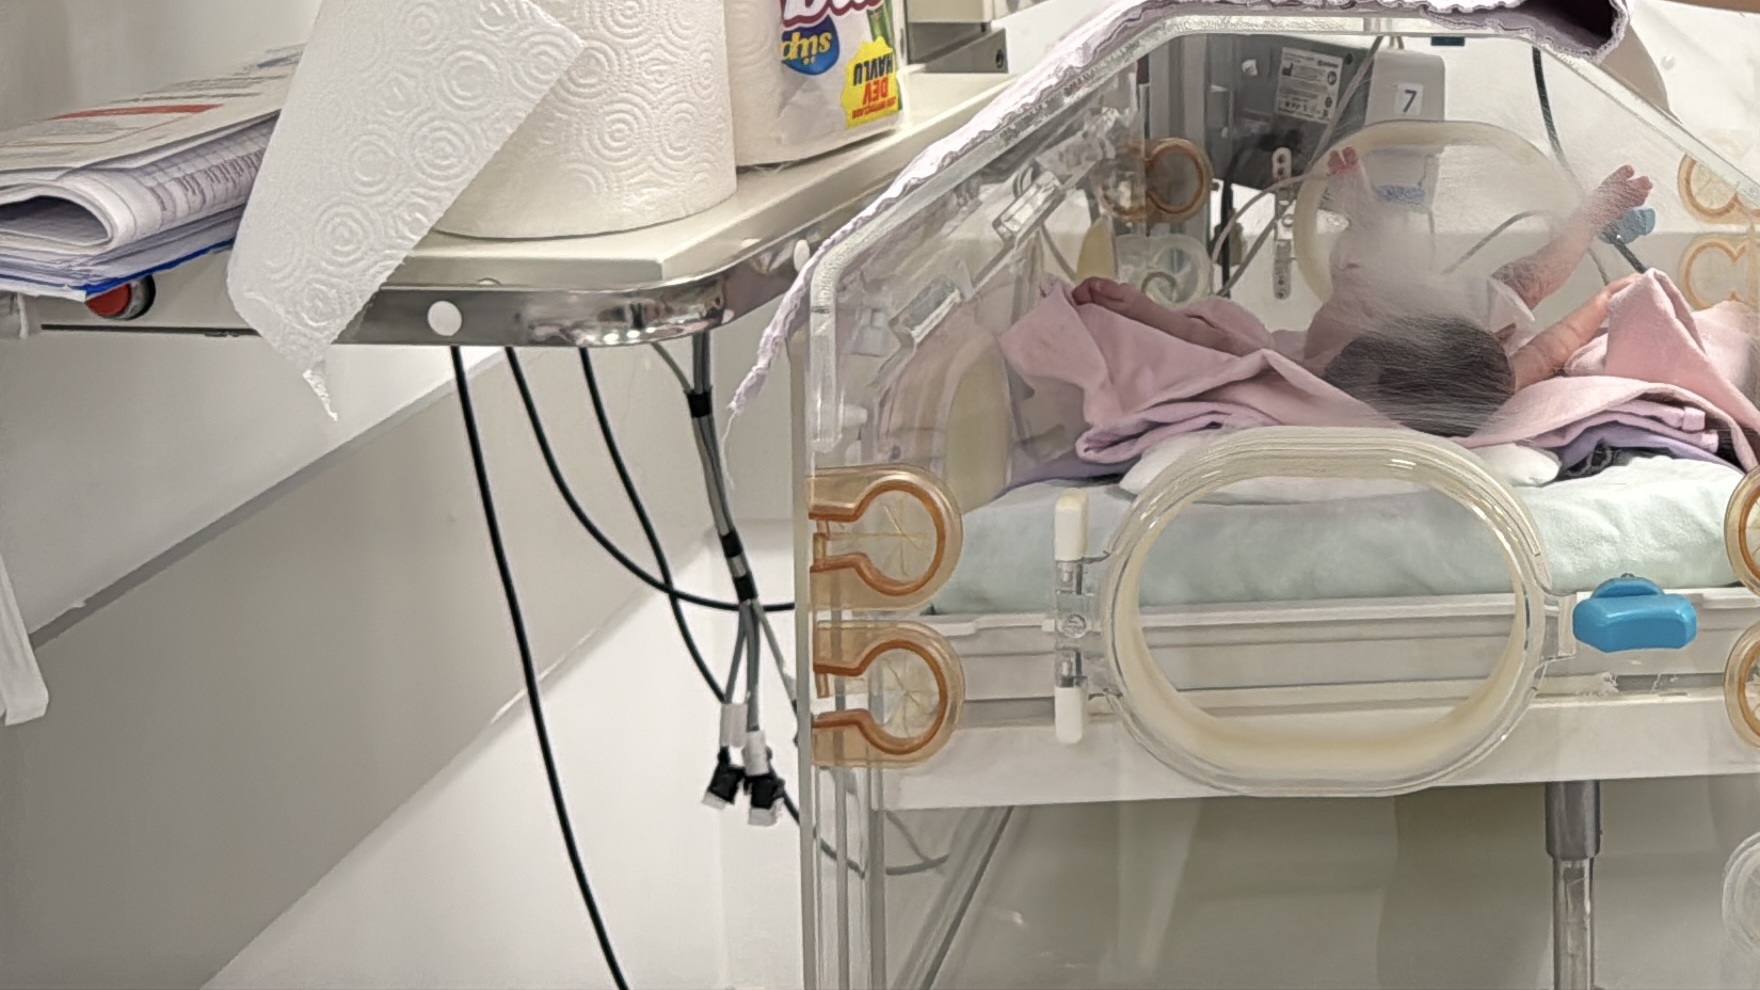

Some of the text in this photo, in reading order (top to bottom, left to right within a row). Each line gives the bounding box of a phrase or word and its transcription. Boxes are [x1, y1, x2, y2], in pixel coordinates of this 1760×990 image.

[852, 54, 894, 86] HAVLU
[862, 77, 889, 106] DEV
[1402, 89, 1418, 113] 7
